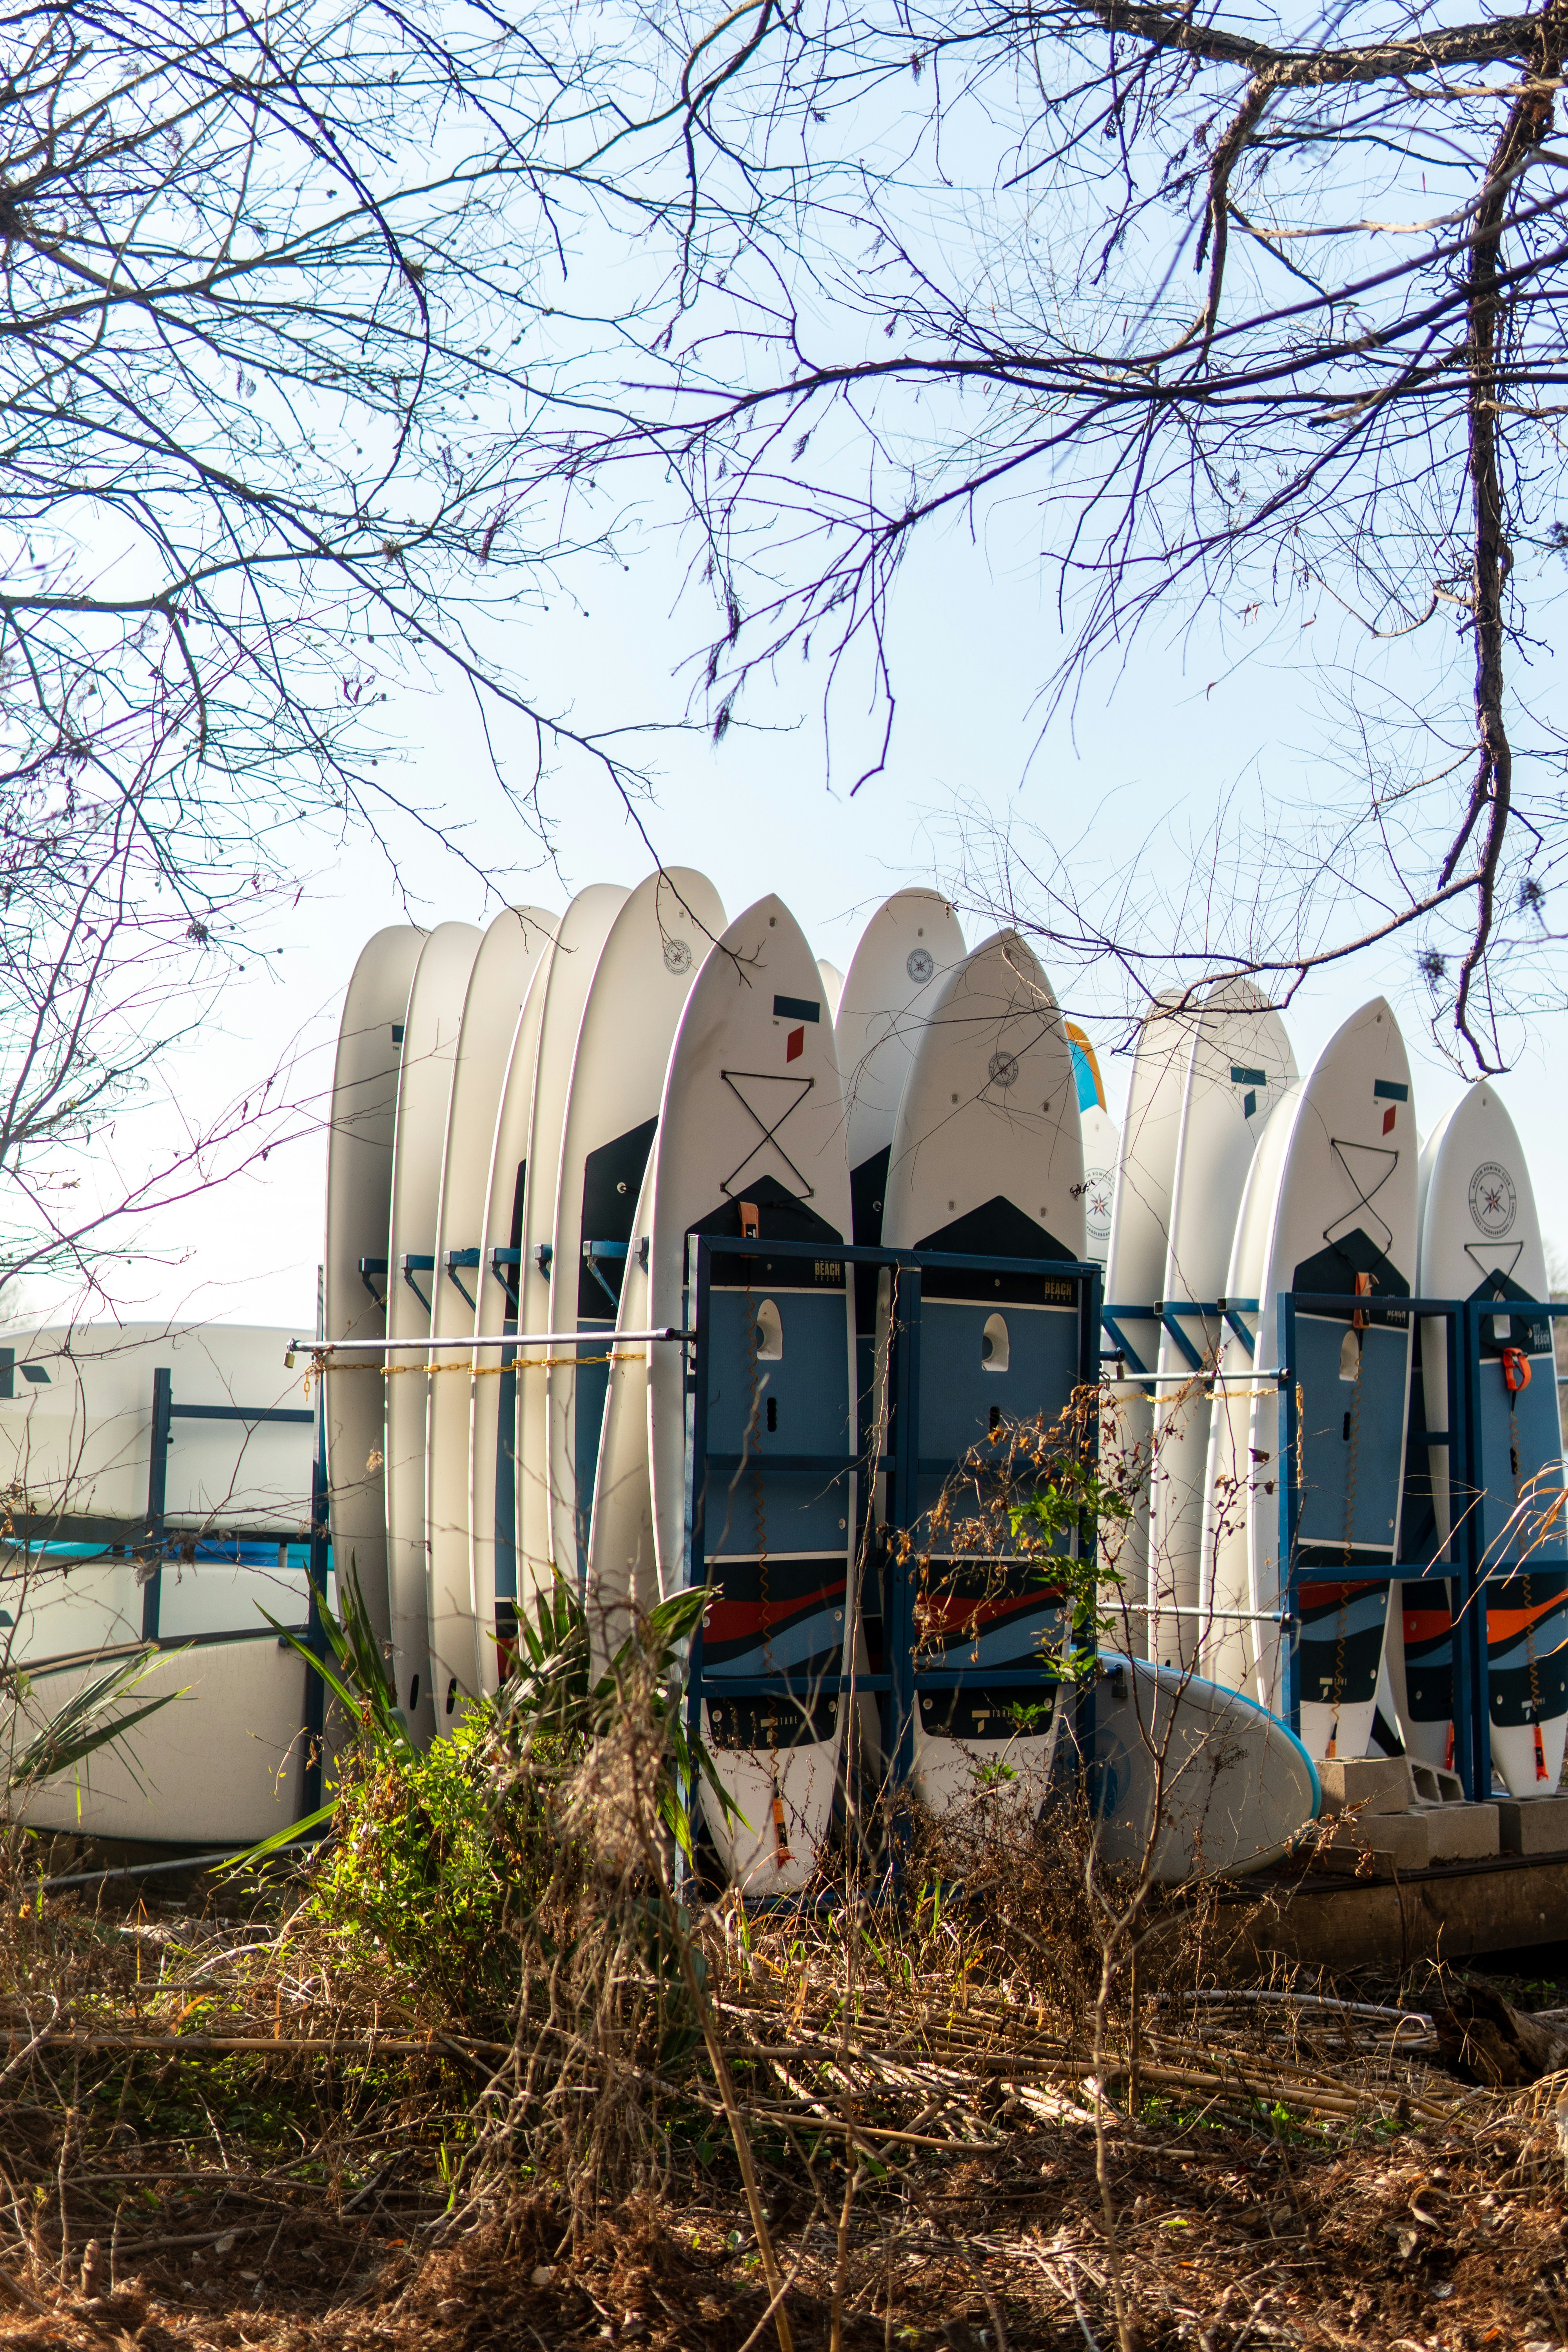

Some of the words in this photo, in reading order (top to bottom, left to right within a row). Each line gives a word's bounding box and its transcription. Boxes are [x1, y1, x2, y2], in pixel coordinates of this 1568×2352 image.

[815, 1263, 840, 1276] BEACH
[1045, 1282, 1072, 1295] BEACH
[780, 1716, 797, 1725] TAHE
